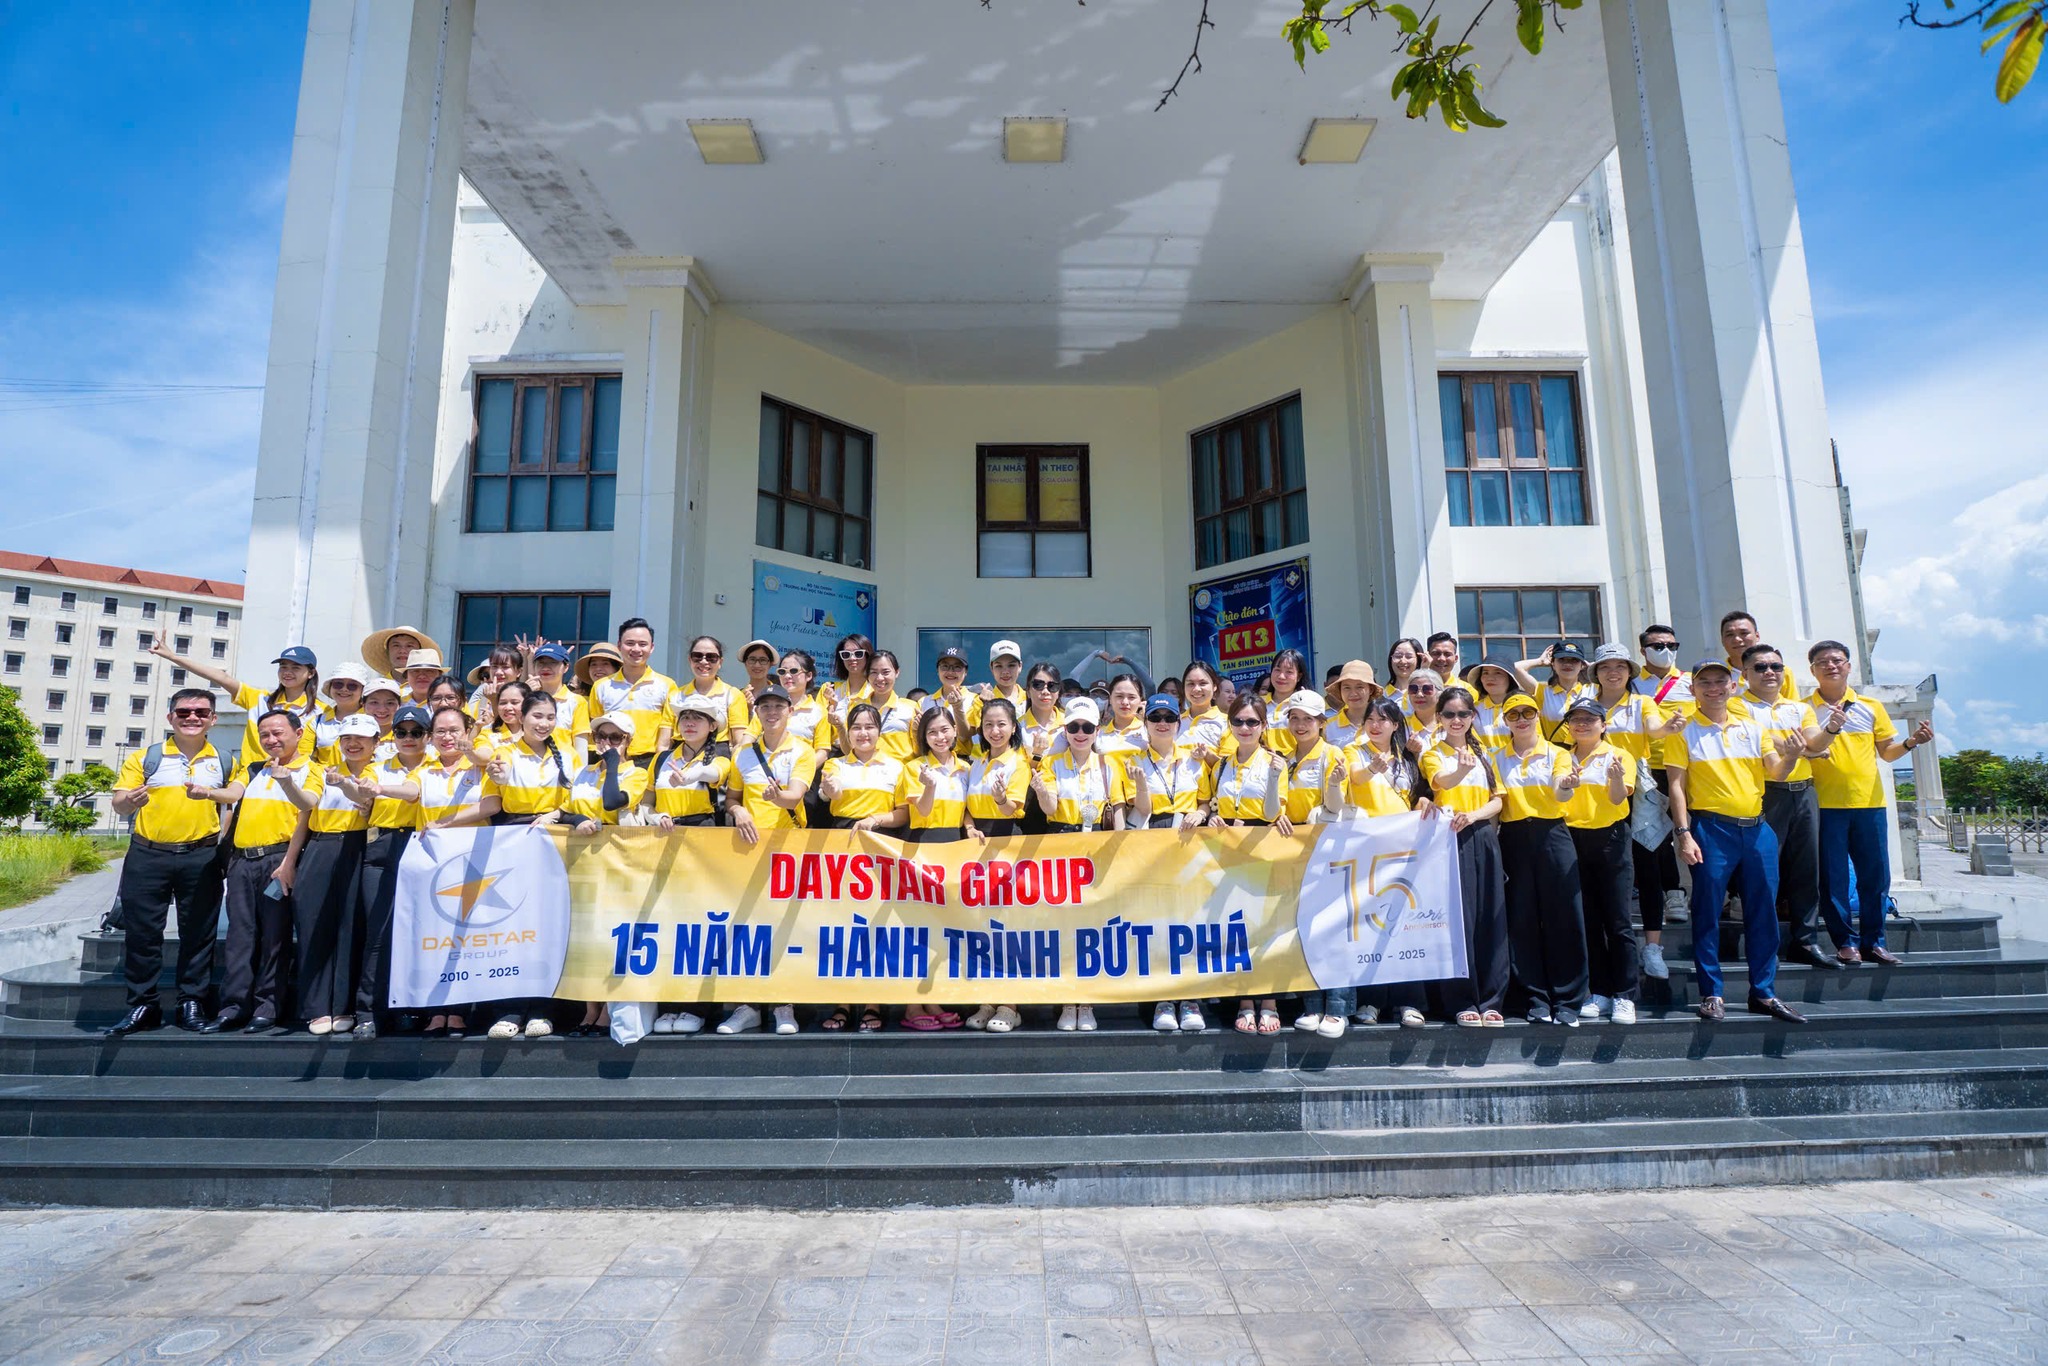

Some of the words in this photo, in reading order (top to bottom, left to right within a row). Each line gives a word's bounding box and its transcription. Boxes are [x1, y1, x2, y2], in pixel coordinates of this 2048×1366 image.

[1050, 464, 1074, 472] THEO
[1215, 610, 1240, 627] Chào
[1241, 606, 1258, 619] đón
[769, 620, 790, 634] Your
[791, 622, 818, 635] Future
[1225, 627, 1269, 653] K13
[1238, 659, 1255, 667] SINH
[769, 852, 946, 907] DAYSTAR
[960, 856, 1095, 908] GROUP
[421, 930, 537, 951] DAYSTAR
[611, 922, 660, 976] 15
[672, 911, 773, 977] NĂM
[786, 945, 804, 955] -
[817, 912, 930, 979] HÀNH
[943, 918, 1061, 979] TRÌNH
[1075, 914, 1154, 978] BỨT
[1168, 909, 1253, 975] PHÁ
[448, 949, 508, 961] GROUP
[1357, 953, 1382, 964] 2010
[1398, 948, 1426, 960] 2025
[440, 971, 469, 983] 2010
[488, 966, 520, 979] 2025
